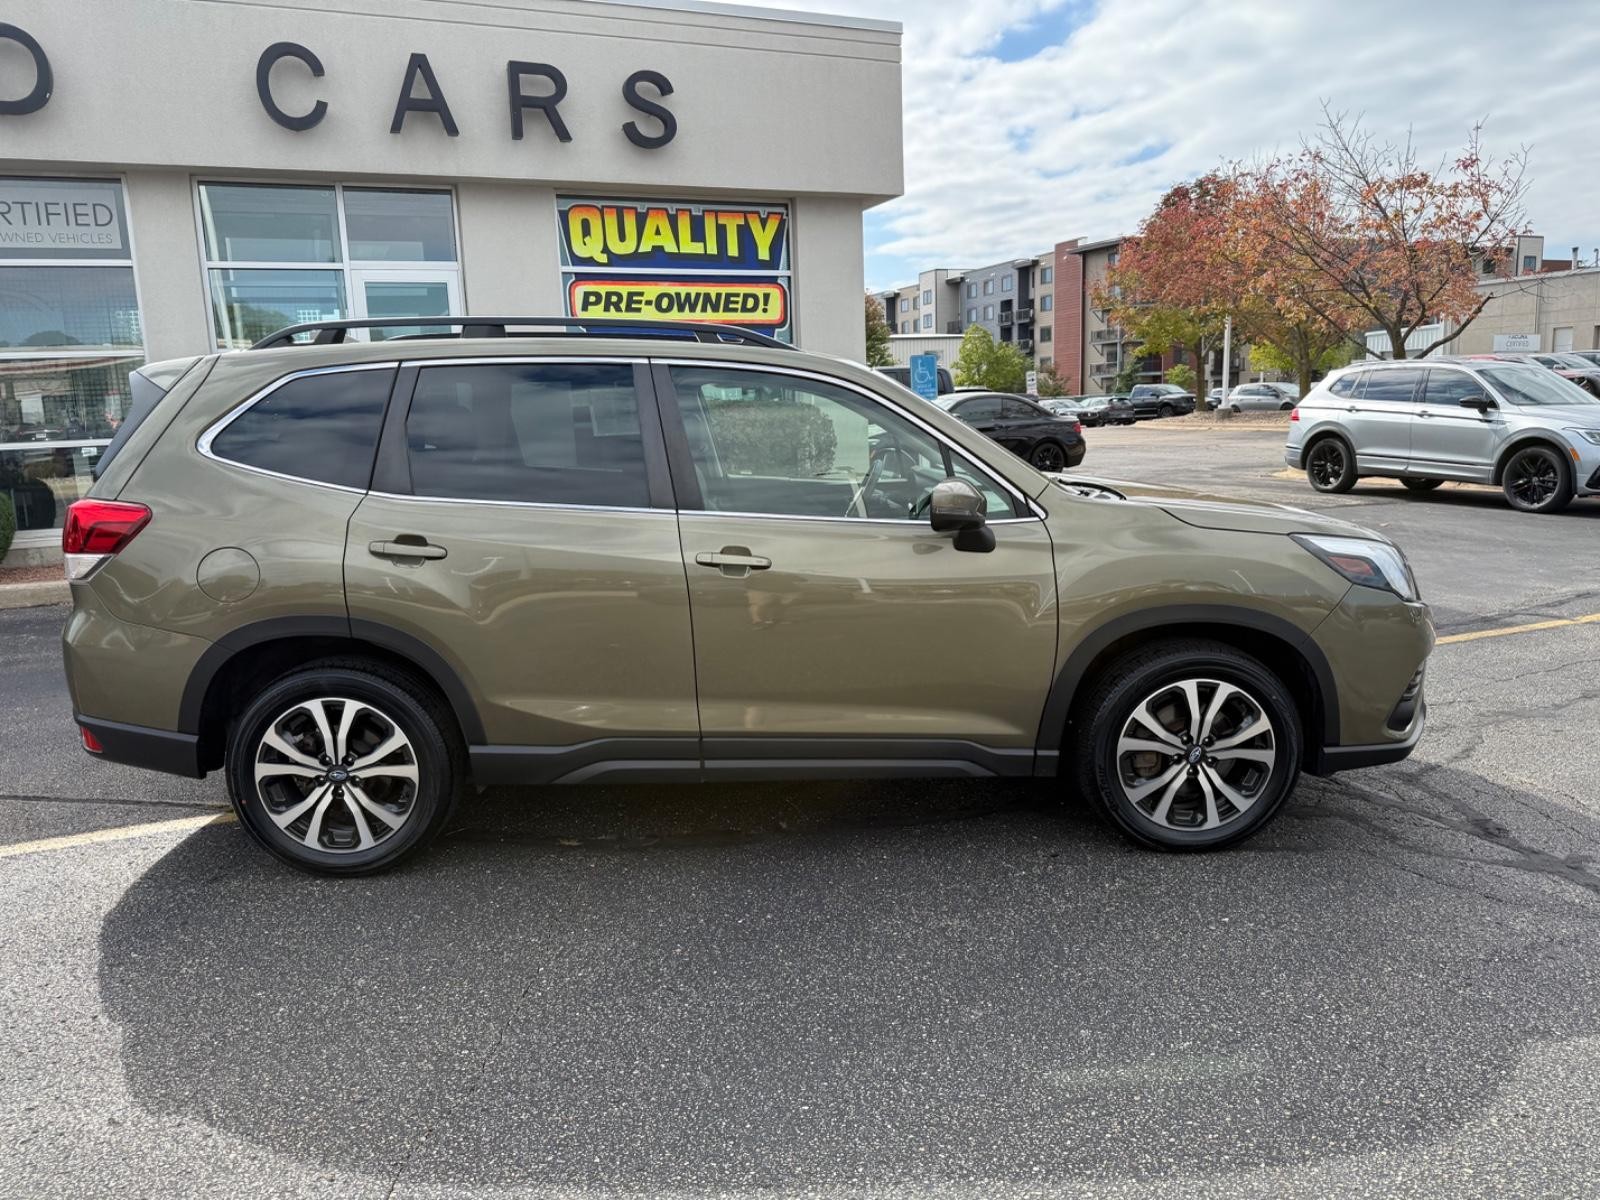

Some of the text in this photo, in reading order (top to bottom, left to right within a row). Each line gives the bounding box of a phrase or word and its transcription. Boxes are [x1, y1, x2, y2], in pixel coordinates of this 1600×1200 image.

[256, 41, 679, 149] CARS
[48, 232, 113, 244] VEHICLES
[567, 203, 783, 264] QUALITY
[581, 290, 771, 313] PRE-OWNED!
